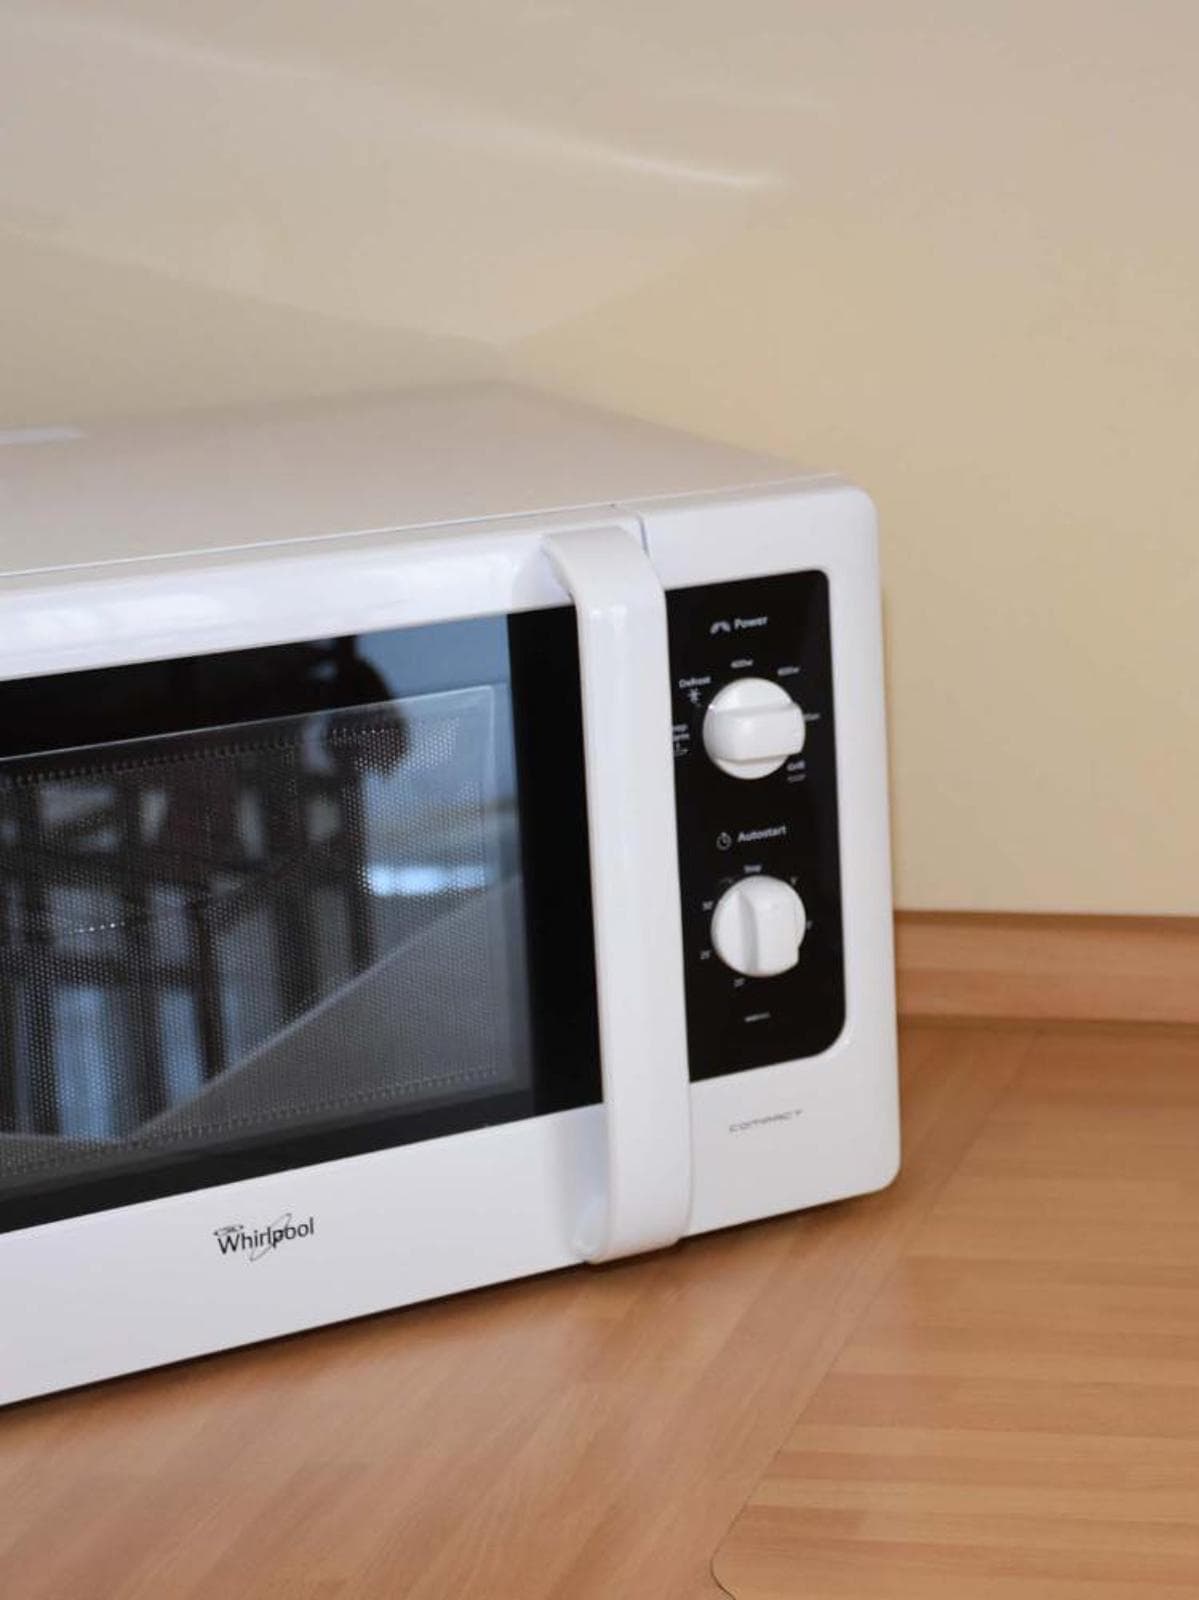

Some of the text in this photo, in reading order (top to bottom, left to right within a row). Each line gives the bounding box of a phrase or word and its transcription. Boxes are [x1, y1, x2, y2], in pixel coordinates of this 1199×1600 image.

[734, 616, 768, 630] Power
[737, 825, 787, 843] Autostart
[216, 1216, 315, 1255] Whirlpool
